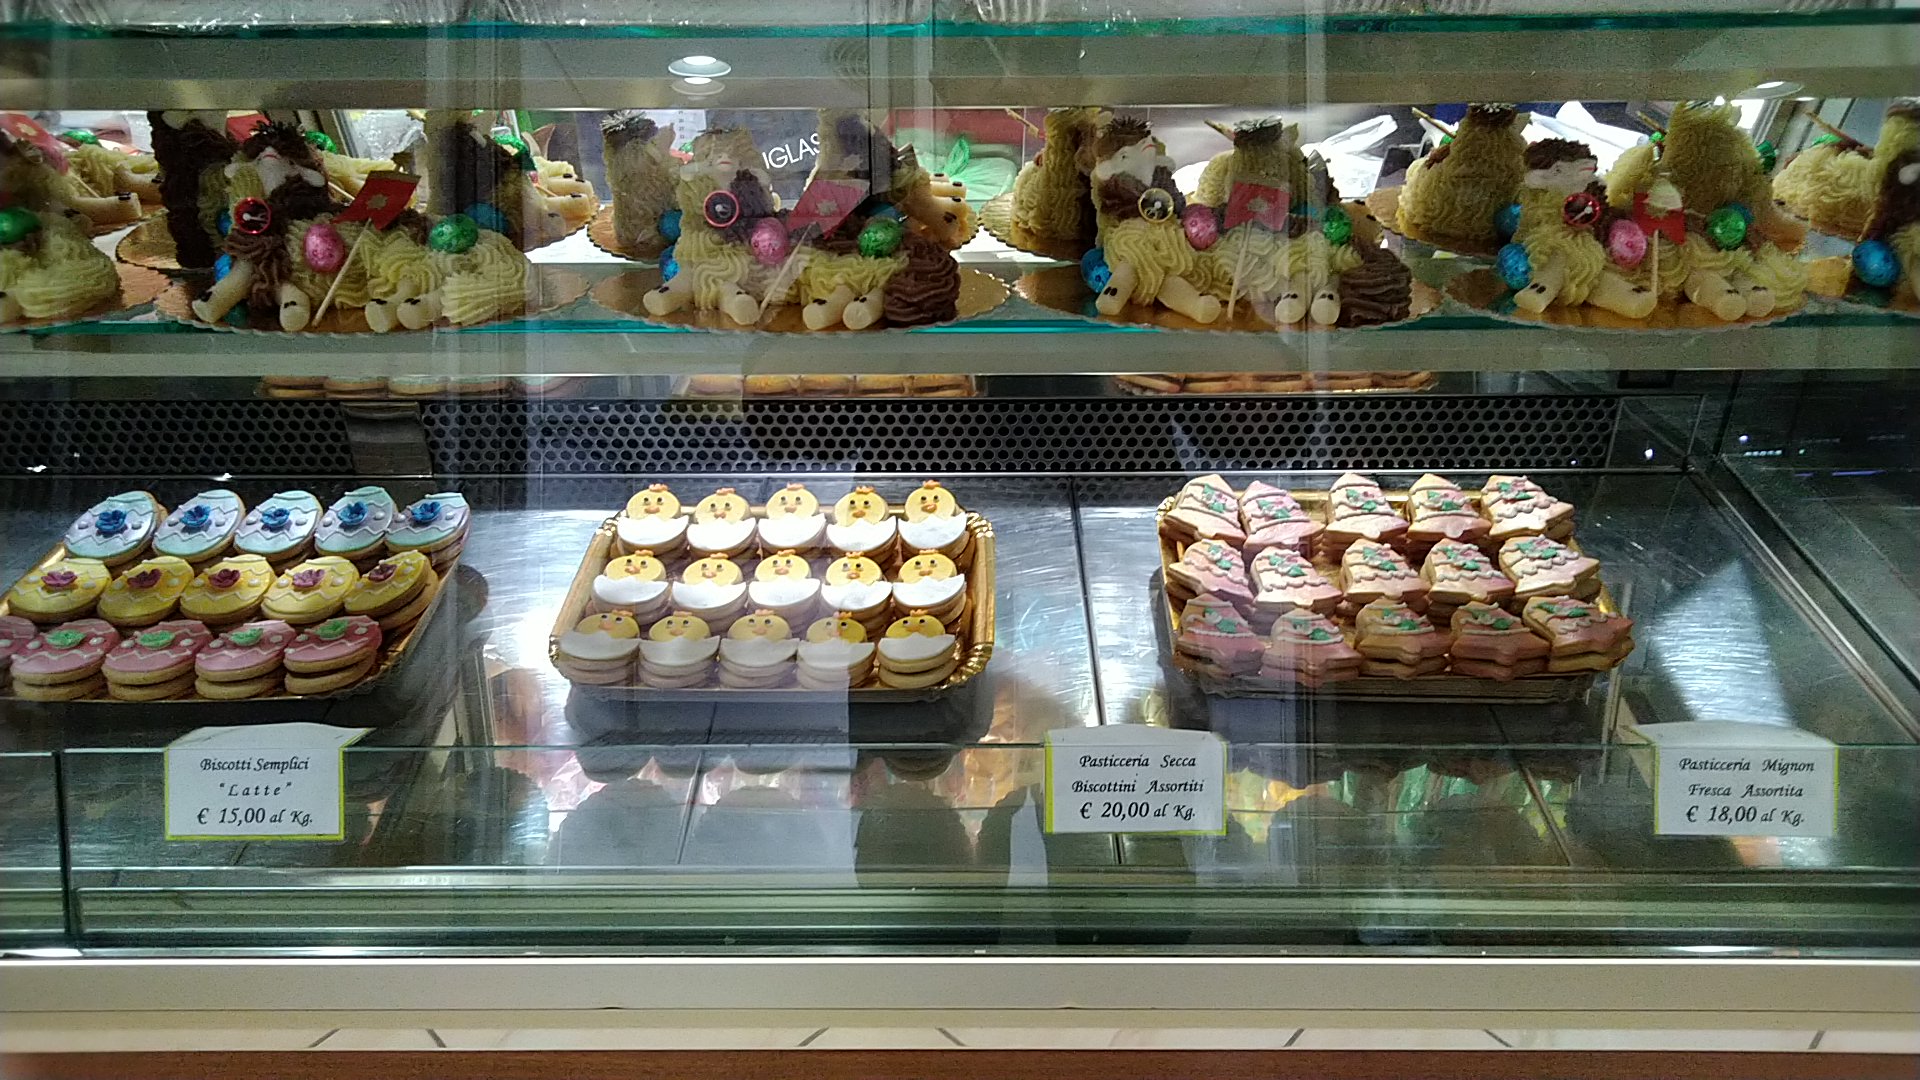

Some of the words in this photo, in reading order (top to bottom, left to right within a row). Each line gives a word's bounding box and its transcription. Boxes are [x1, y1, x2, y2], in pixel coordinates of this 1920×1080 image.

[200, 757, 251, 771] Biscotti
[253, 756, 311, 774] Semplici
[1079, 754, 1149, 768] Pasticceria
[1160, 754, 1196, 768] Secca
[1679, 757, 1750, 771] Pasticceria
[1762, 758, 1815, 776] Mignon
[1072, 779, 1136, 793] Biscottini
[1145, 779, 1205, 794] Assortiti
[1688, 783, 1732, 796] Fresca
[1741, 784, 1803, 798] Assortita
[197, 807, 210, 825] €
[218, 807, 266, 827] 15,00
[269, 809, 286, 823] al
[291, 810, 313, 827] Kg.
[1080, 802, 1092, 819] €
[1101, 801, 1149, 821] 20,00
[1153, 803, 1170, 817] al
[1173, 804, 1196, 820] Kg.
[1686, 805, 1699, 822] €
[1708, 805, 1757, 825] 18,00
[1760, 808, 1777, 822] al
[1781, 810, 1805, 827] Kg.
